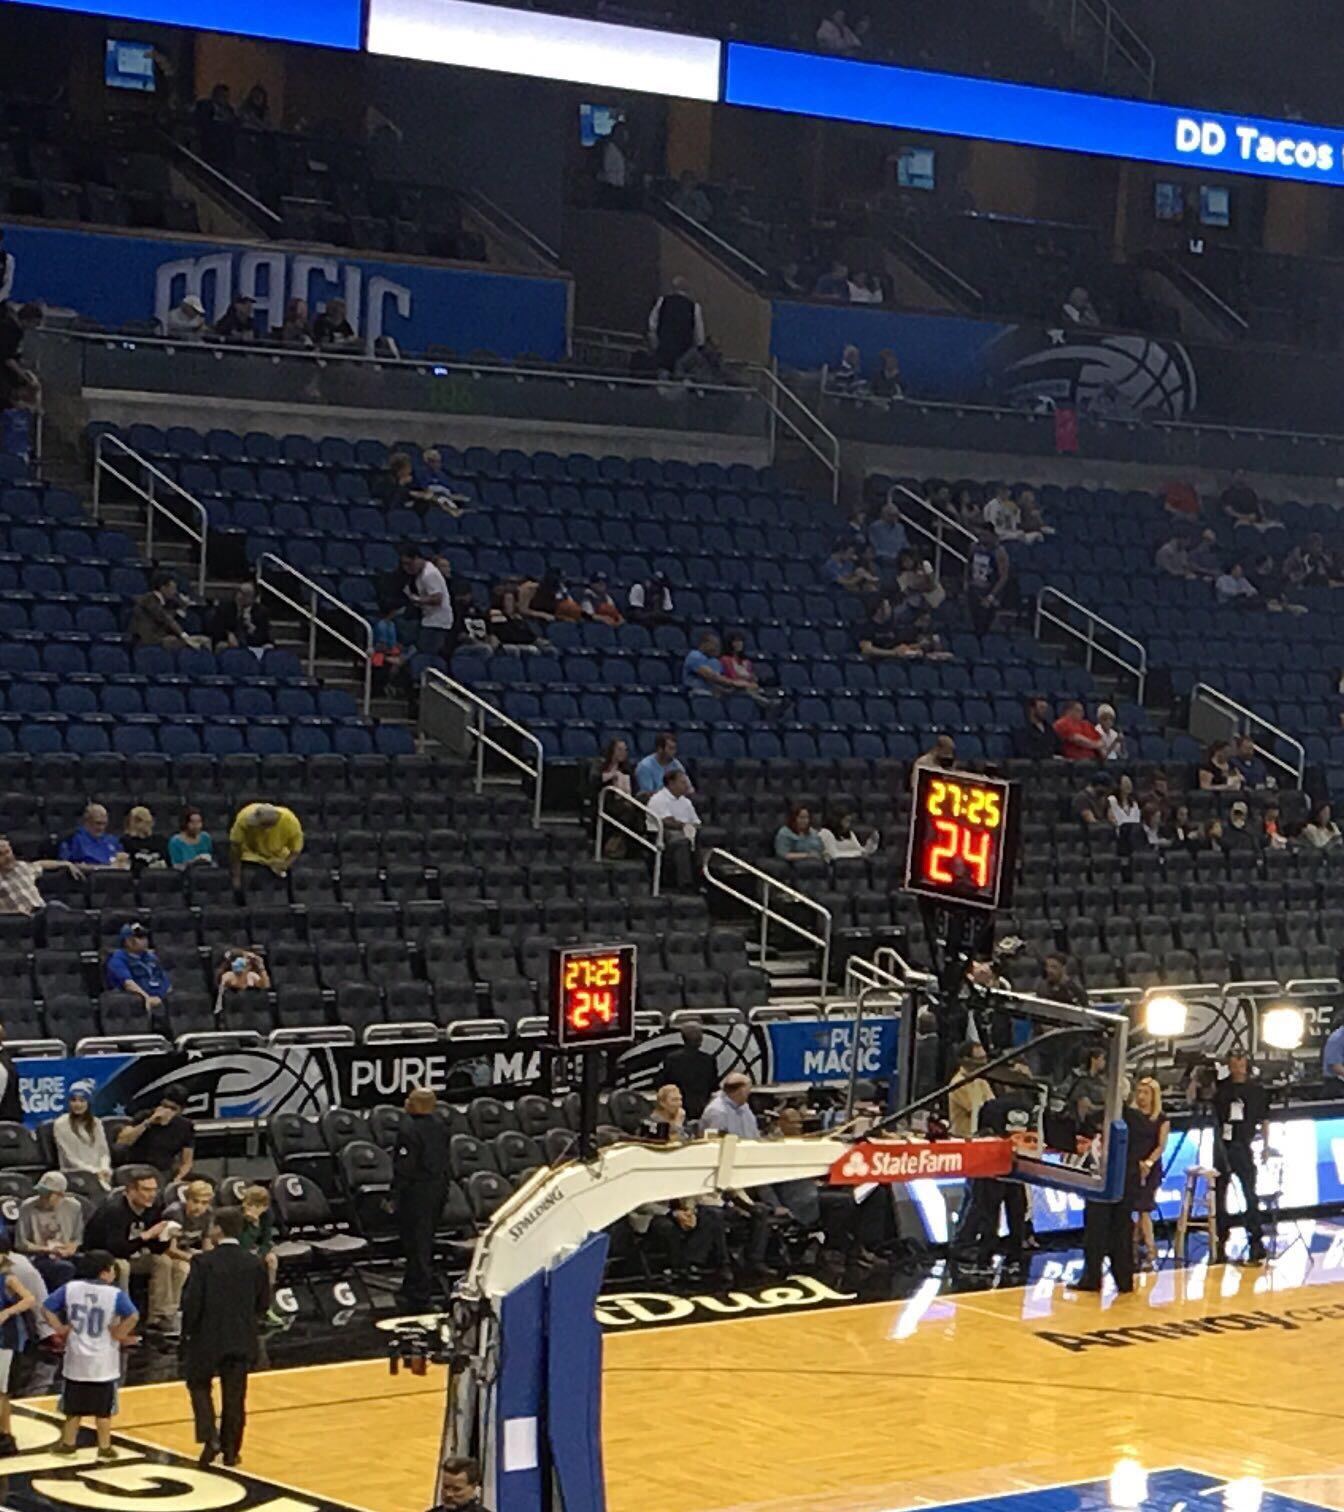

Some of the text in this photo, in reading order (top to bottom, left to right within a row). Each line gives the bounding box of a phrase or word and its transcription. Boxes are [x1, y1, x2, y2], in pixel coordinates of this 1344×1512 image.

[1176, 117, 1226, 155] DD
[1236, 125, 1333, 170] Tacos
[928, 780, 1000, 828] 27:25
[929, 821, 990, 887] 24
[566, 958, 621, 990] 27:25
[572, 992, 612, 1029] 24
[831, 1026, 883, 1047] PURE
[350, 1056, 447, 1097] PURE
[804, 1048, 881, 1074] MAGIC
[19, 1094, 65, 1114] AGIC
[508, 1185, 565, 1242] SPALDING
[70, 1302, 105, 1339] 50
[1036, 1309, 1300, 1352] Amway
